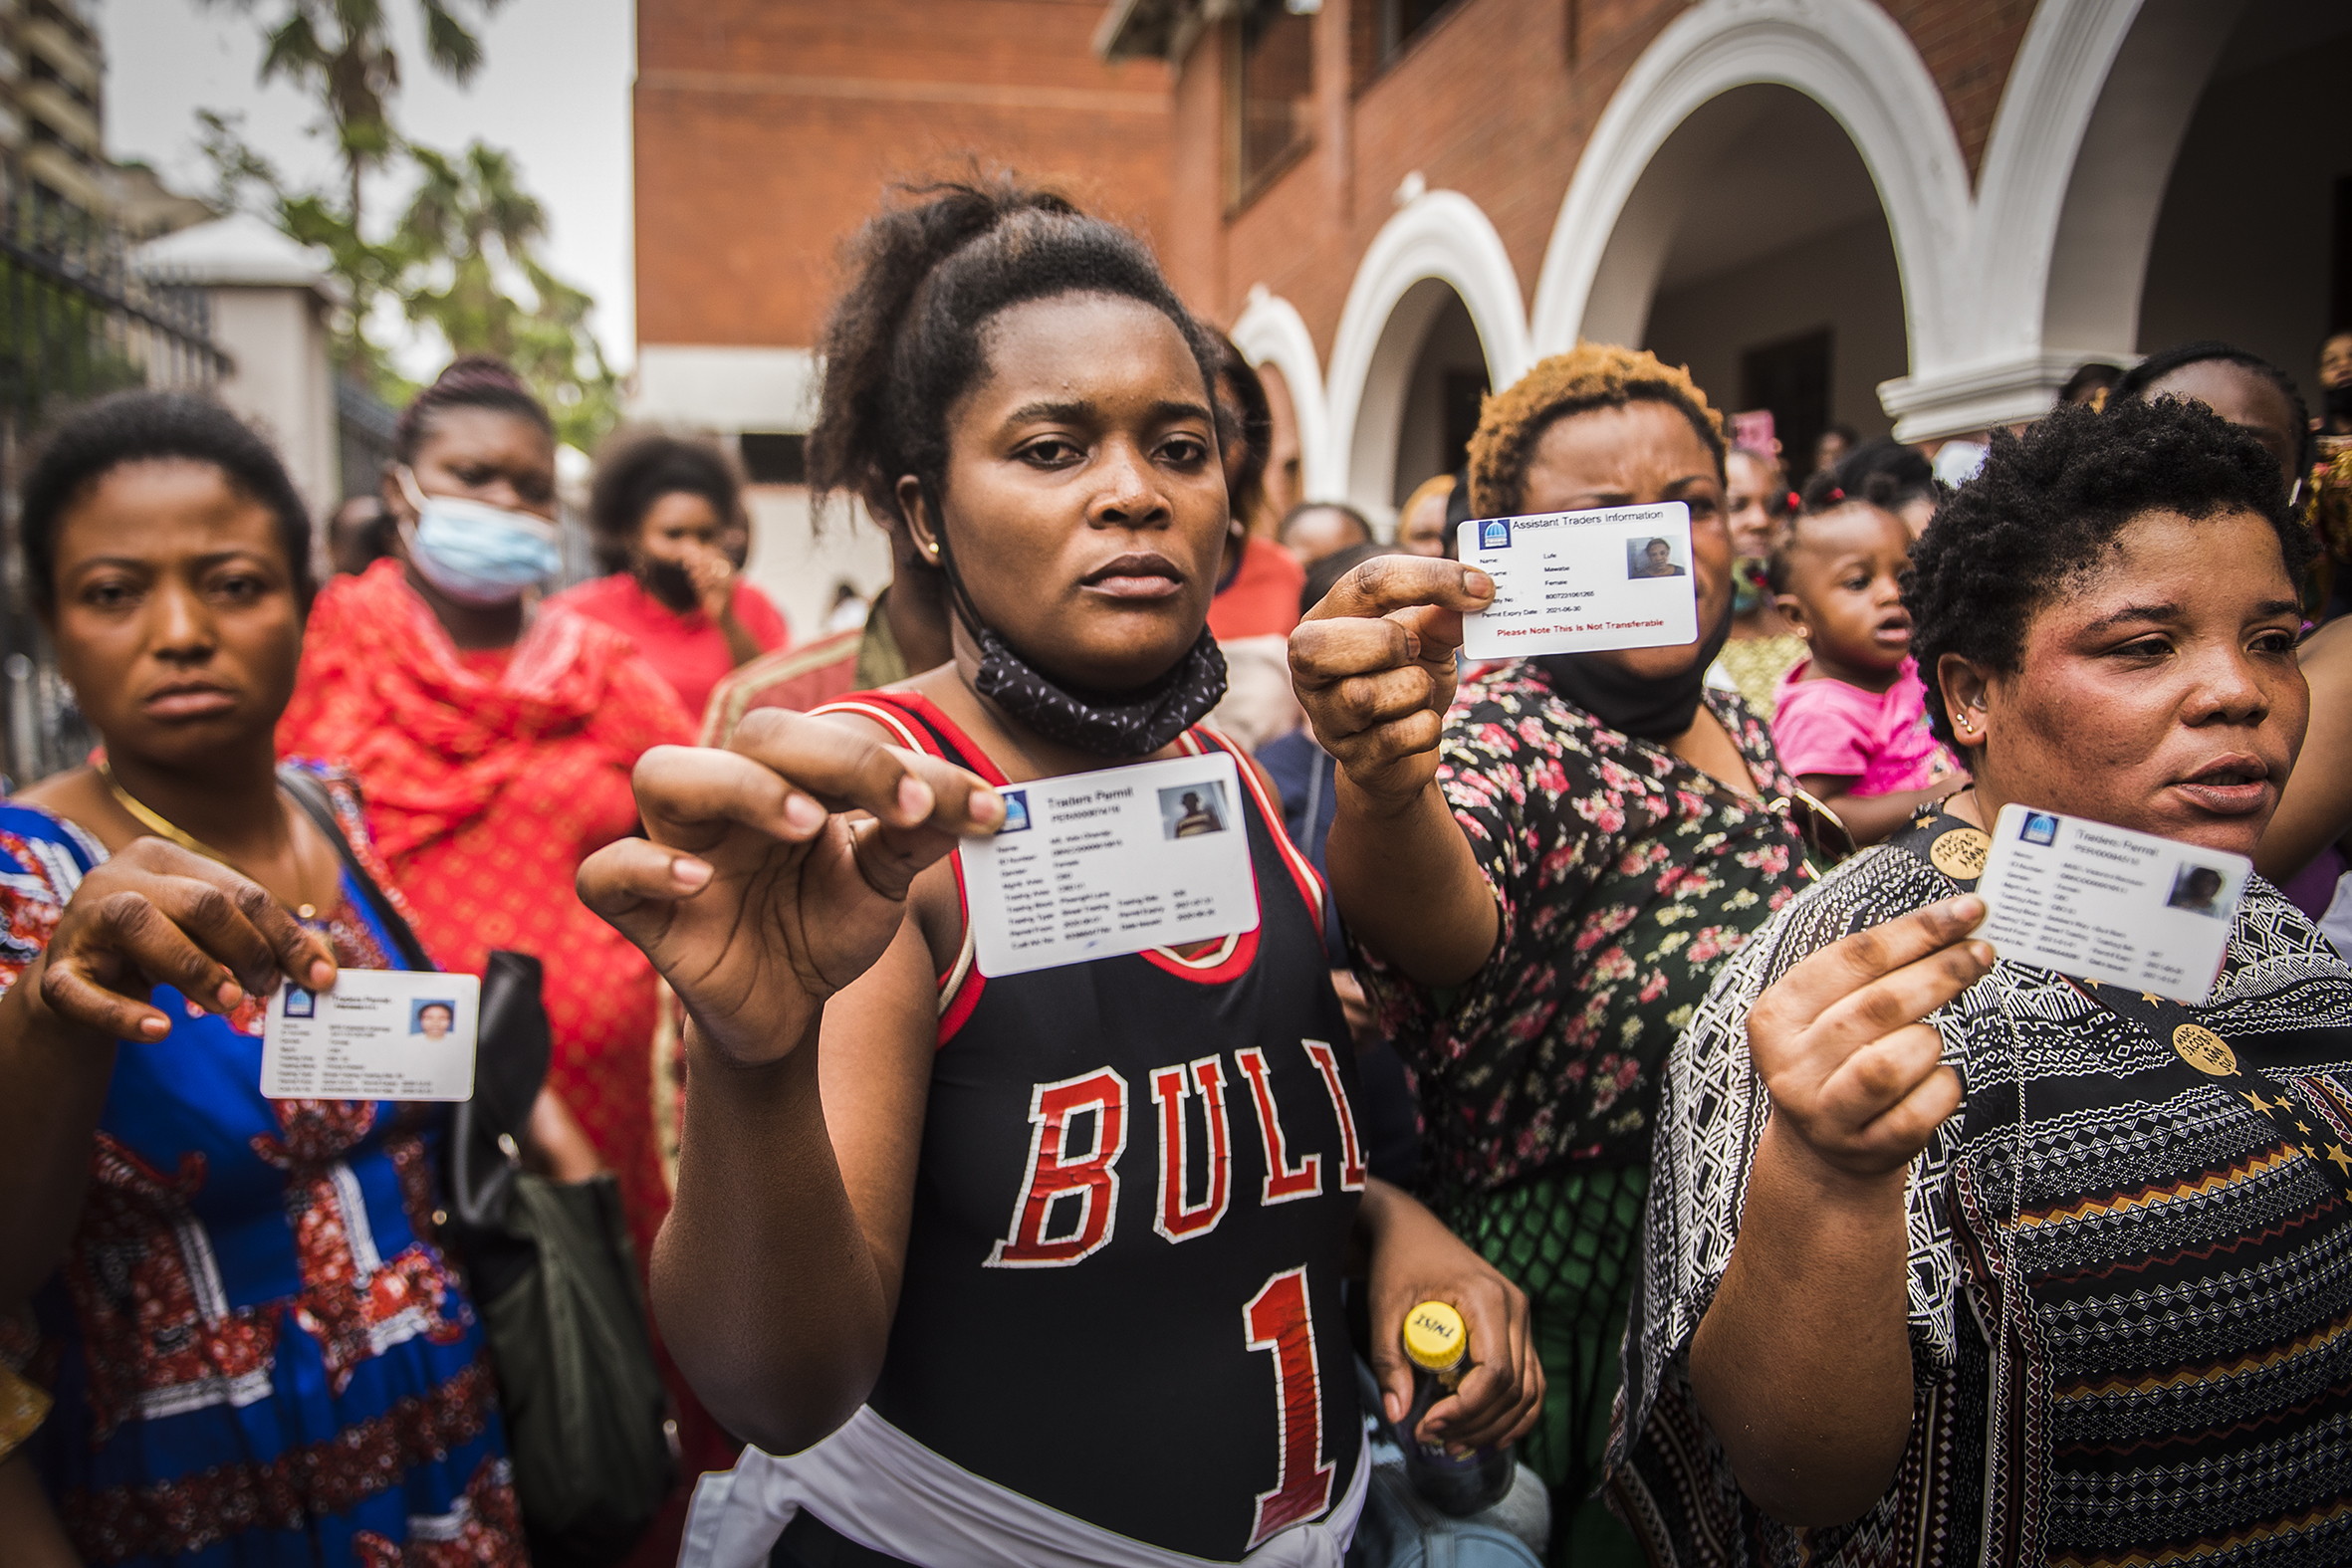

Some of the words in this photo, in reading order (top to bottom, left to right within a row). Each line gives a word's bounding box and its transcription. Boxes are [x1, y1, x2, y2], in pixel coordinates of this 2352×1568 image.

[1513, 519, 1559, 530] Assistant
[1562, 515, 1601, 525] Traders
[1606, 511, 1663, 522] Information
[1606, 619, 1664, 629] Transferable
[2176, 1027, 2195, 1046] MARC
[2182, 1030, 2214, 1056] JACOBS
[1412, 1312, 1454, 1340] TWIST
[1242, 1263, 1336, 1551] 1
